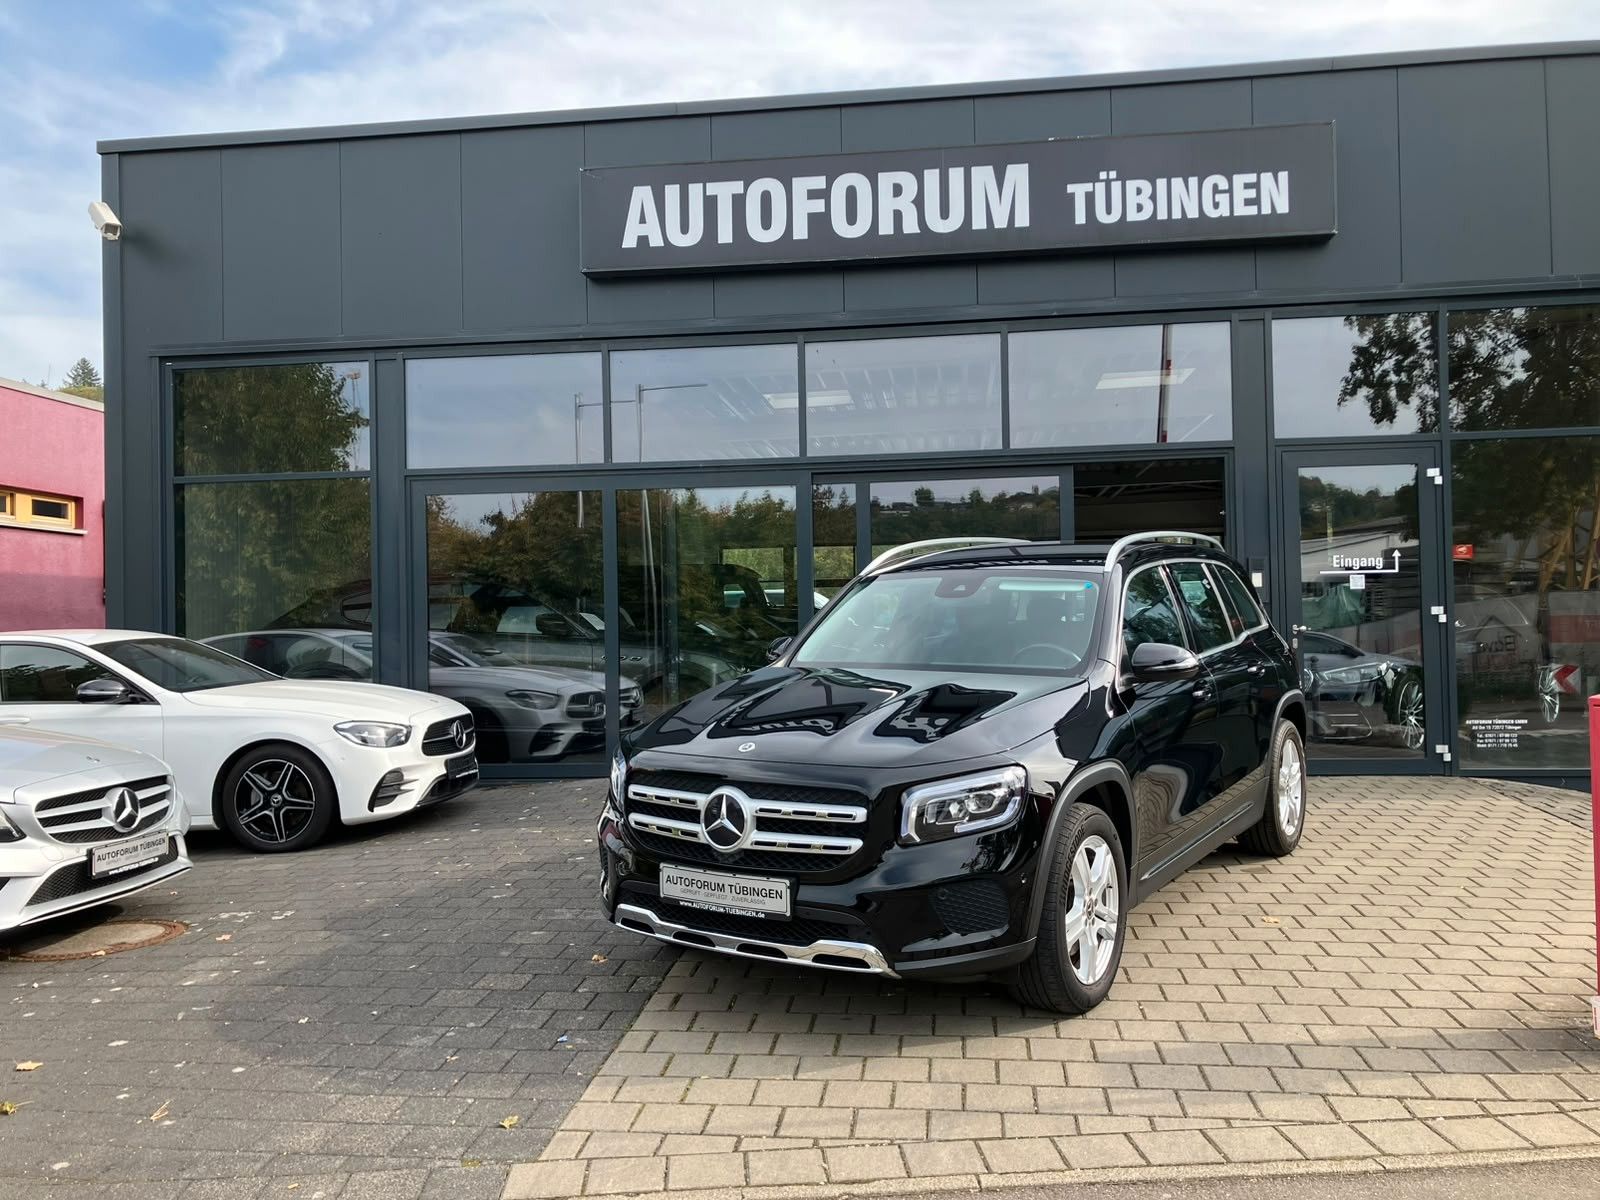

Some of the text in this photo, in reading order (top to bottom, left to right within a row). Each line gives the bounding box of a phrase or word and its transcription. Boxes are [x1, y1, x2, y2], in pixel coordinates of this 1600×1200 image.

[621, 162, 1290, 249] AUTOFORUM TÜBINGEN
[1332, 555, 1383, 569] Eingang
[97, 845, 139, 862] AUTOFORUM
[140, 837, 166, 850] TÜBINGEN
[665, 874, 783, 900] AUTOFORUM TÜBINGEN
[679, 900, 765, 918] www.AUTOFORUM-TUEBINGEN.de
